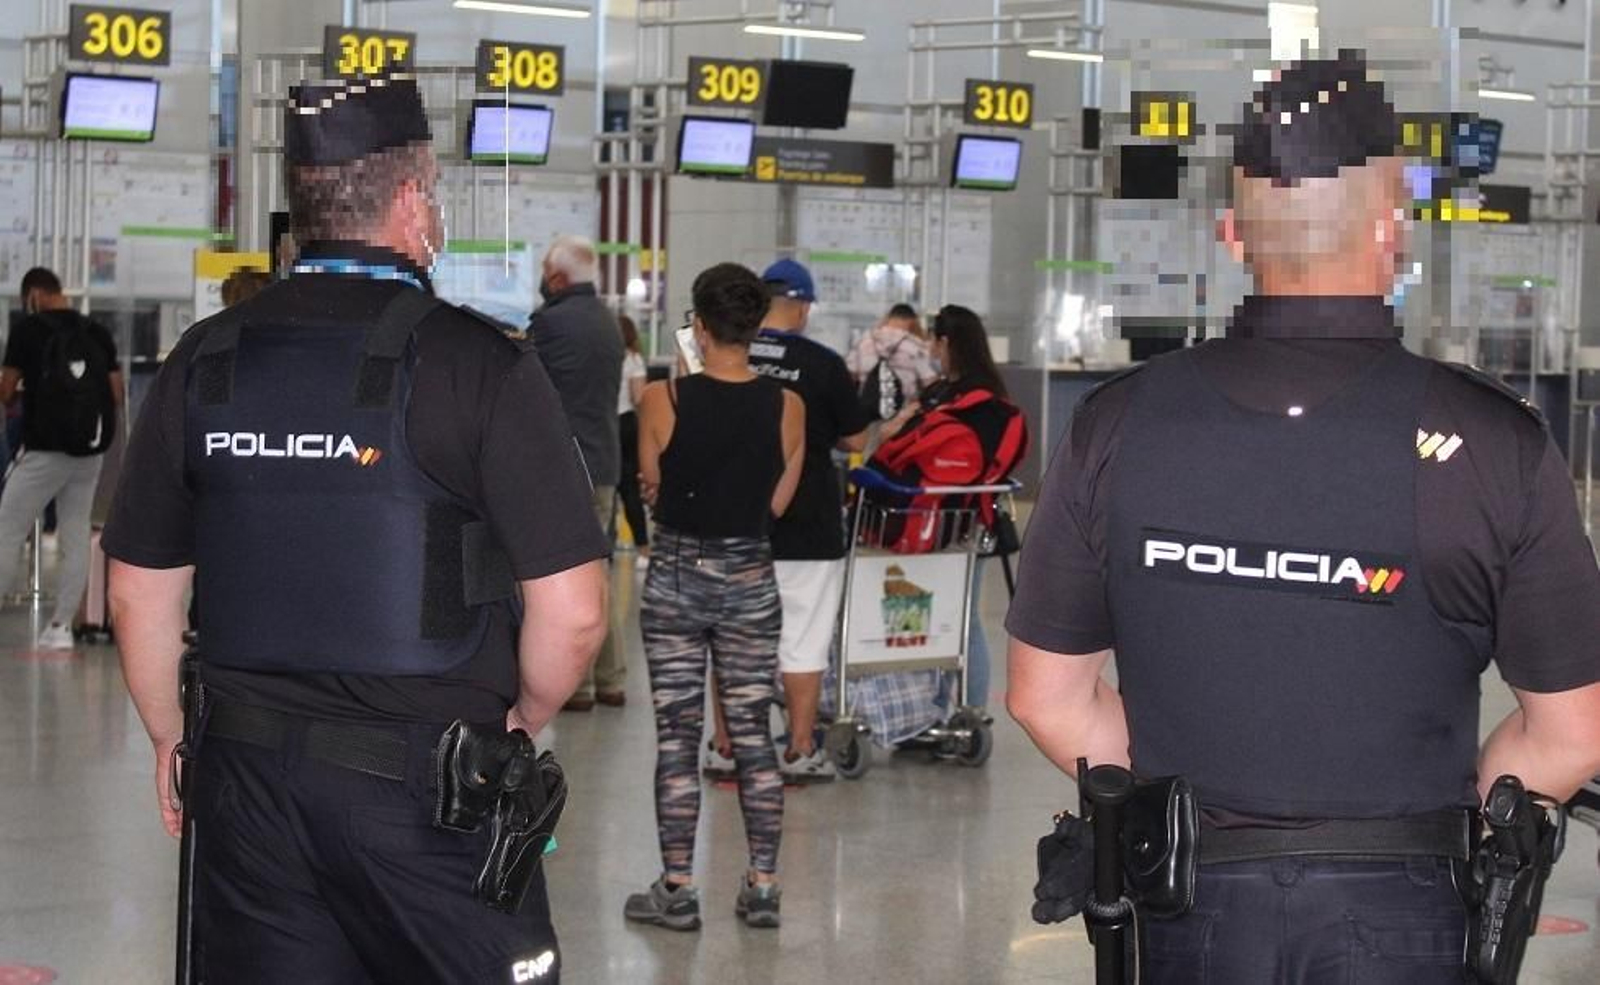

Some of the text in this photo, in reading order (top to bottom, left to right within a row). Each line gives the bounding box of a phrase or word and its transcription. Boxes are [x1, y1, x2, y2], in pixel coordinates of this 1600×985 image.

[82, 12, 162, 58] 306
[486, 46, 559, 90] 308
[698, 64, 760, 103] 309
[974, 85, 1029, 123] 310
[205, 431, 360, 459] POLICIA
[1144, 539, 1368, 585] POLICIA
[512, 950, 555, 982] CNP
